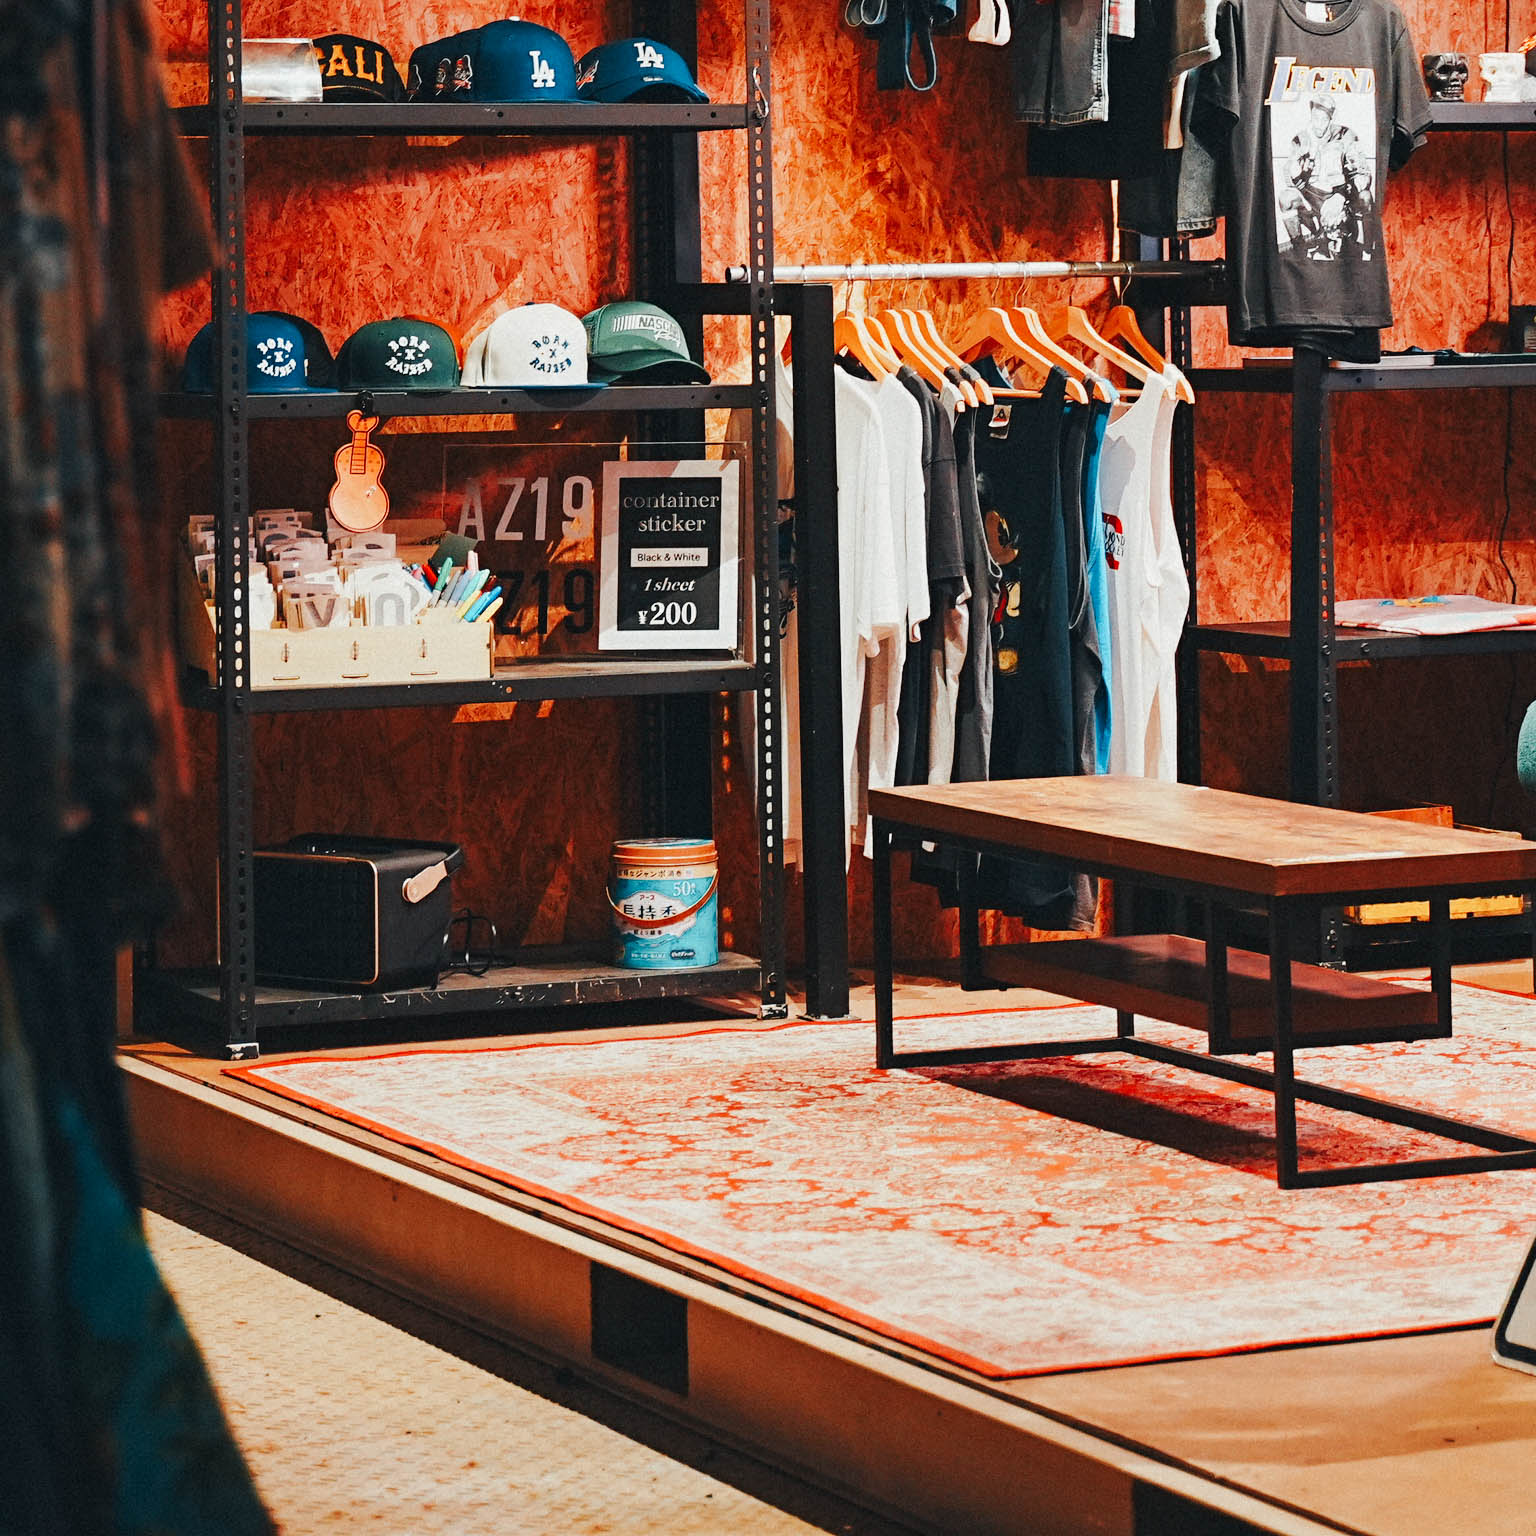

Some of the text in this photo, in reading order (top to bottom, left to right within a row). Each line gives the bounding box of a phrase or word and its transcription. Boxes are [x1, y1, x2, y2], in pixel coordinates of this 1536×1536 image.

[633, 42, 665, 69] LA
[529, 50, 555, 89] LA
[1264, 56, 1376, 105] LEGEND
[457, 475, 594, 542] AZ19
[623, 492, 720, 509] container
[638, 514, 706, 533] sticker
[637, 552, 701, 563] Black & White
[644, 577, 697, 593] 1 sheet
[638, 601, 698, 626] ¥200
